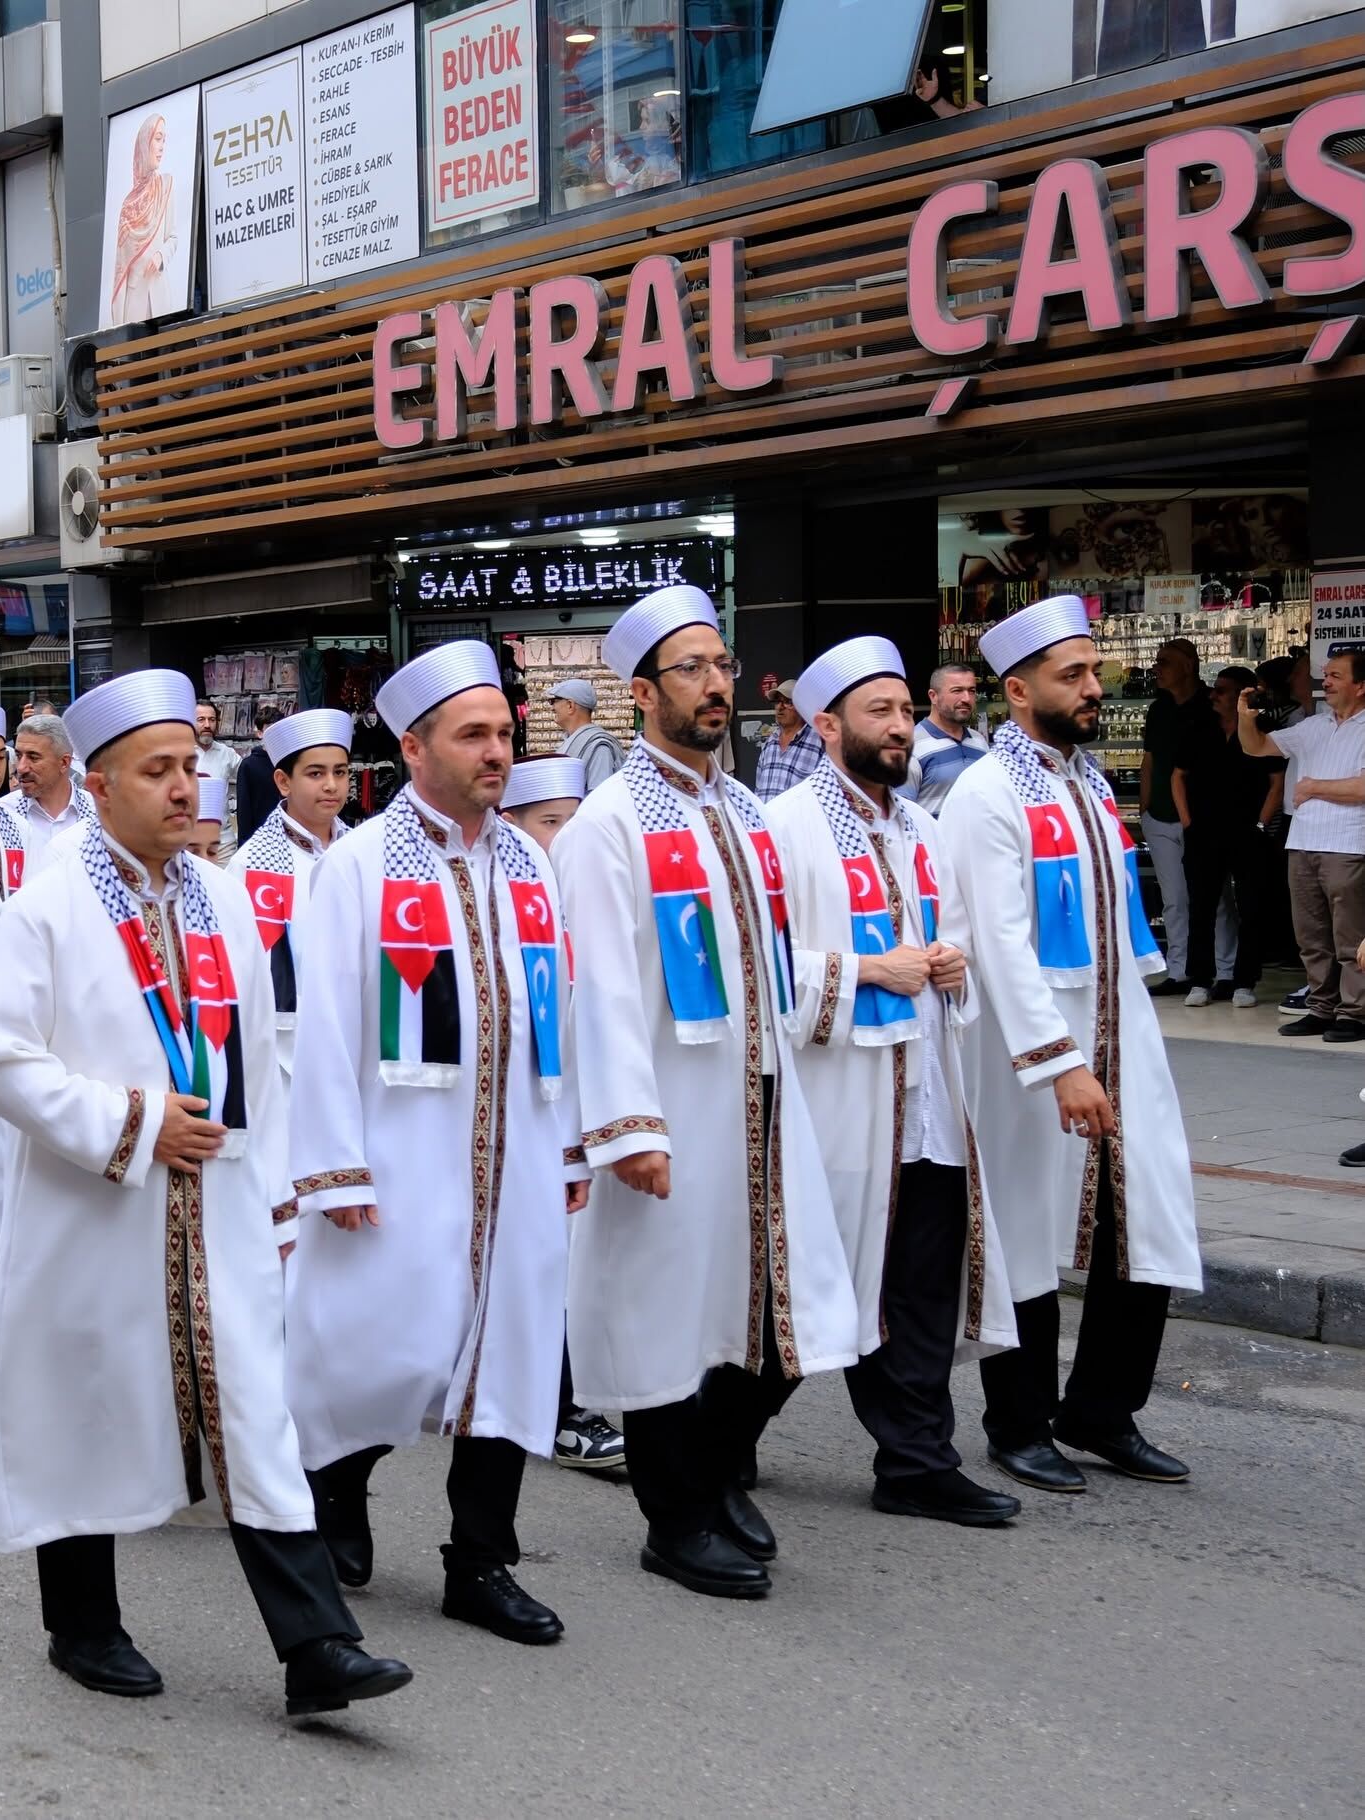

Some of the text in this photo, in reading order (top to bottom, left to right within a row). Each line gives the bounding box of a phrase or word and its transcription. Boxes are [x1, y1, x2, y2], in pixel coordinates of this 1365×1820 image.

[318, 22, 394, 62] KUR'AN-I KERİM
[442, 24, 522, 92] BÜYÜK
[319, 56, 362, 83] SECCADE
[371, 40, 404, 64] TESBİH
[319, 81, 350, 103] RAHLE
[320, 102, 351, 124] ESANS
[444, 83, 522, 147] BEDEN
[213, 110, 293, 167] ZEHRA
[320, 121, 357, 144] FERACE
[225, 154, 283, 188] TESETTÜR
[321, 144, 352, 165] İHRAM
[321, 152, 393, 185] CÜBBE & SARIK
[439, 138, 529, 203] FERACE
[215, 185, 295, 226] HAC & UMRE
[322, 179, 370, 206] HEDİYELİK
[215, 207, 295, 250] MALZEMELERİ
[322, 211, 339, 230] ŞAL
[347, 199, 377, 222] EŞARP
[322, 214, 399, 247] TESETTÜR GİYİM
[323, 238, 393, 267] CENAZE MALZ.
[16, 267, 55, 297] beko
[373, 237, 783, 449] EMRAL
[419, 552, 687, 600] SAAT & BİLEKLİK
[1314, 586, 1343, 602] EMRAL
[1317, 607, 1332, 620] 24
